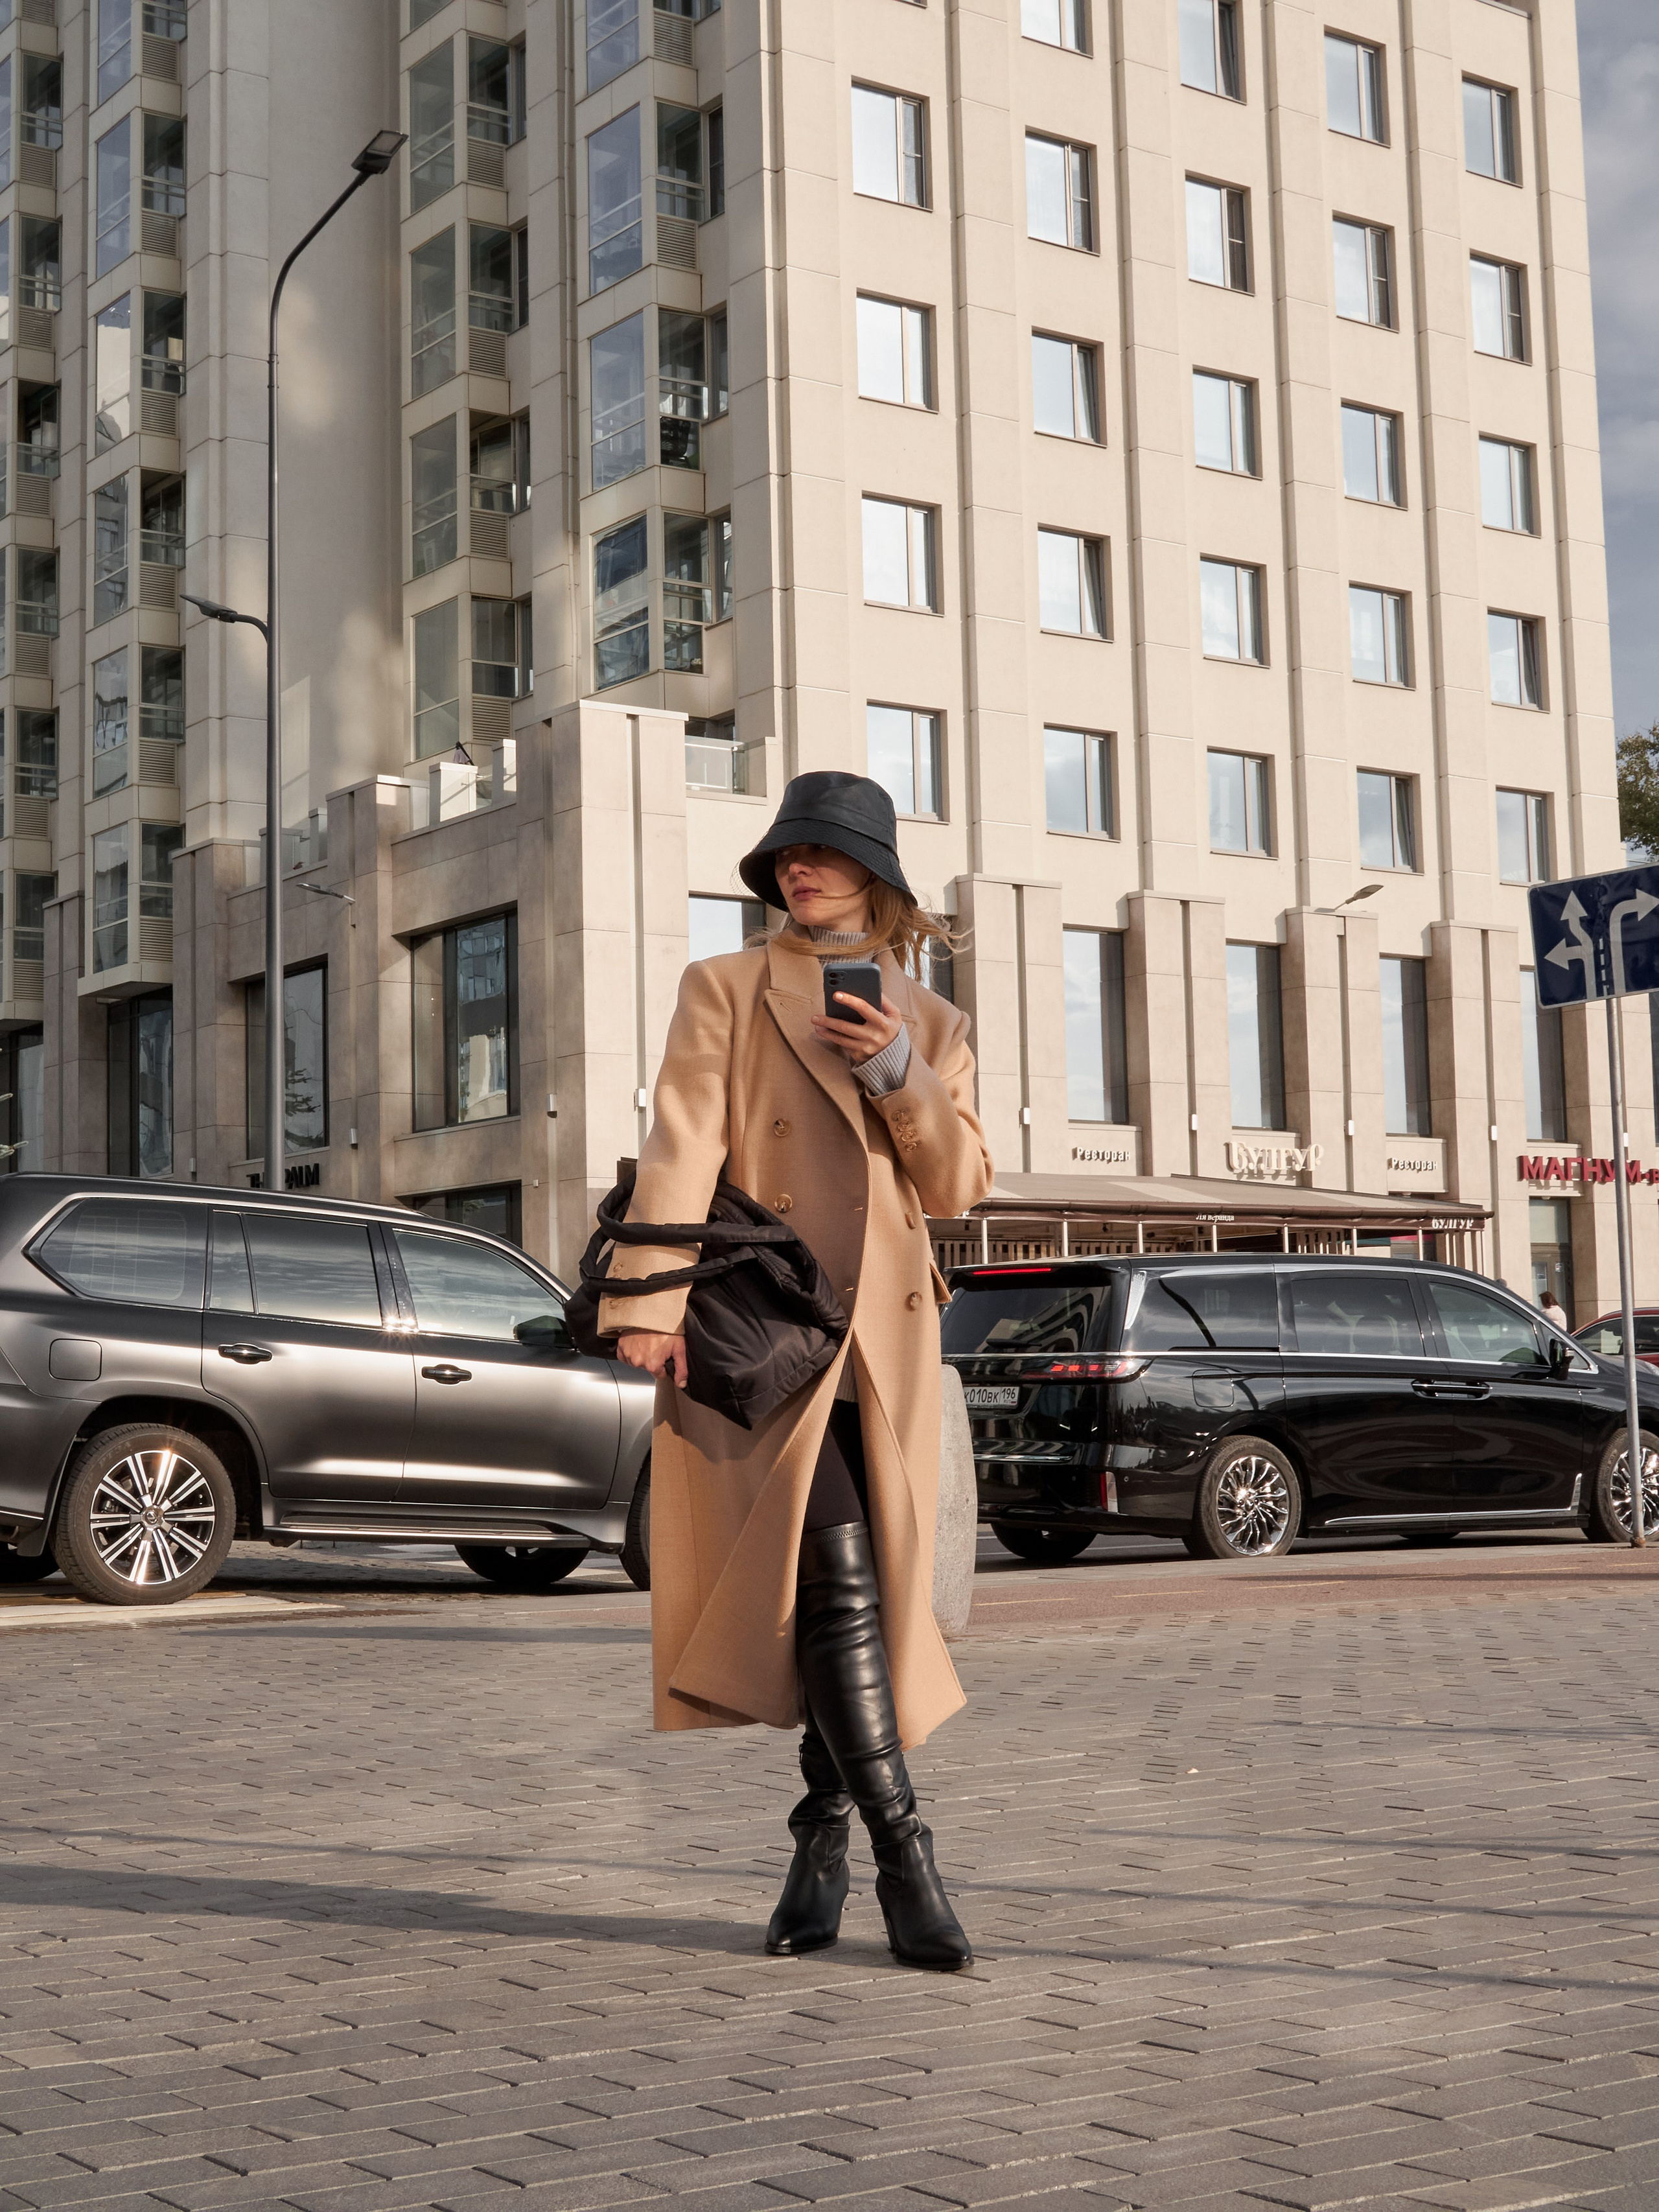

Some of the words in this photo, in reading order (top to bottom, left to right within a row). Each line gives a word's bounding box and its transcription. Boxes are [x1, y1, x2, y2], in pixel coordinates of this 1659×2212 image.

[1075, 1147, 1130, 1164] Ресторан
[1390, 1157, 1437, 1172] Ресторан
[1520, 1156, 1640, 1183] МАГНУМ
[1207, 1214, 1235, 1223] веранда
[1001, 1388, 1015, 1399] 196
